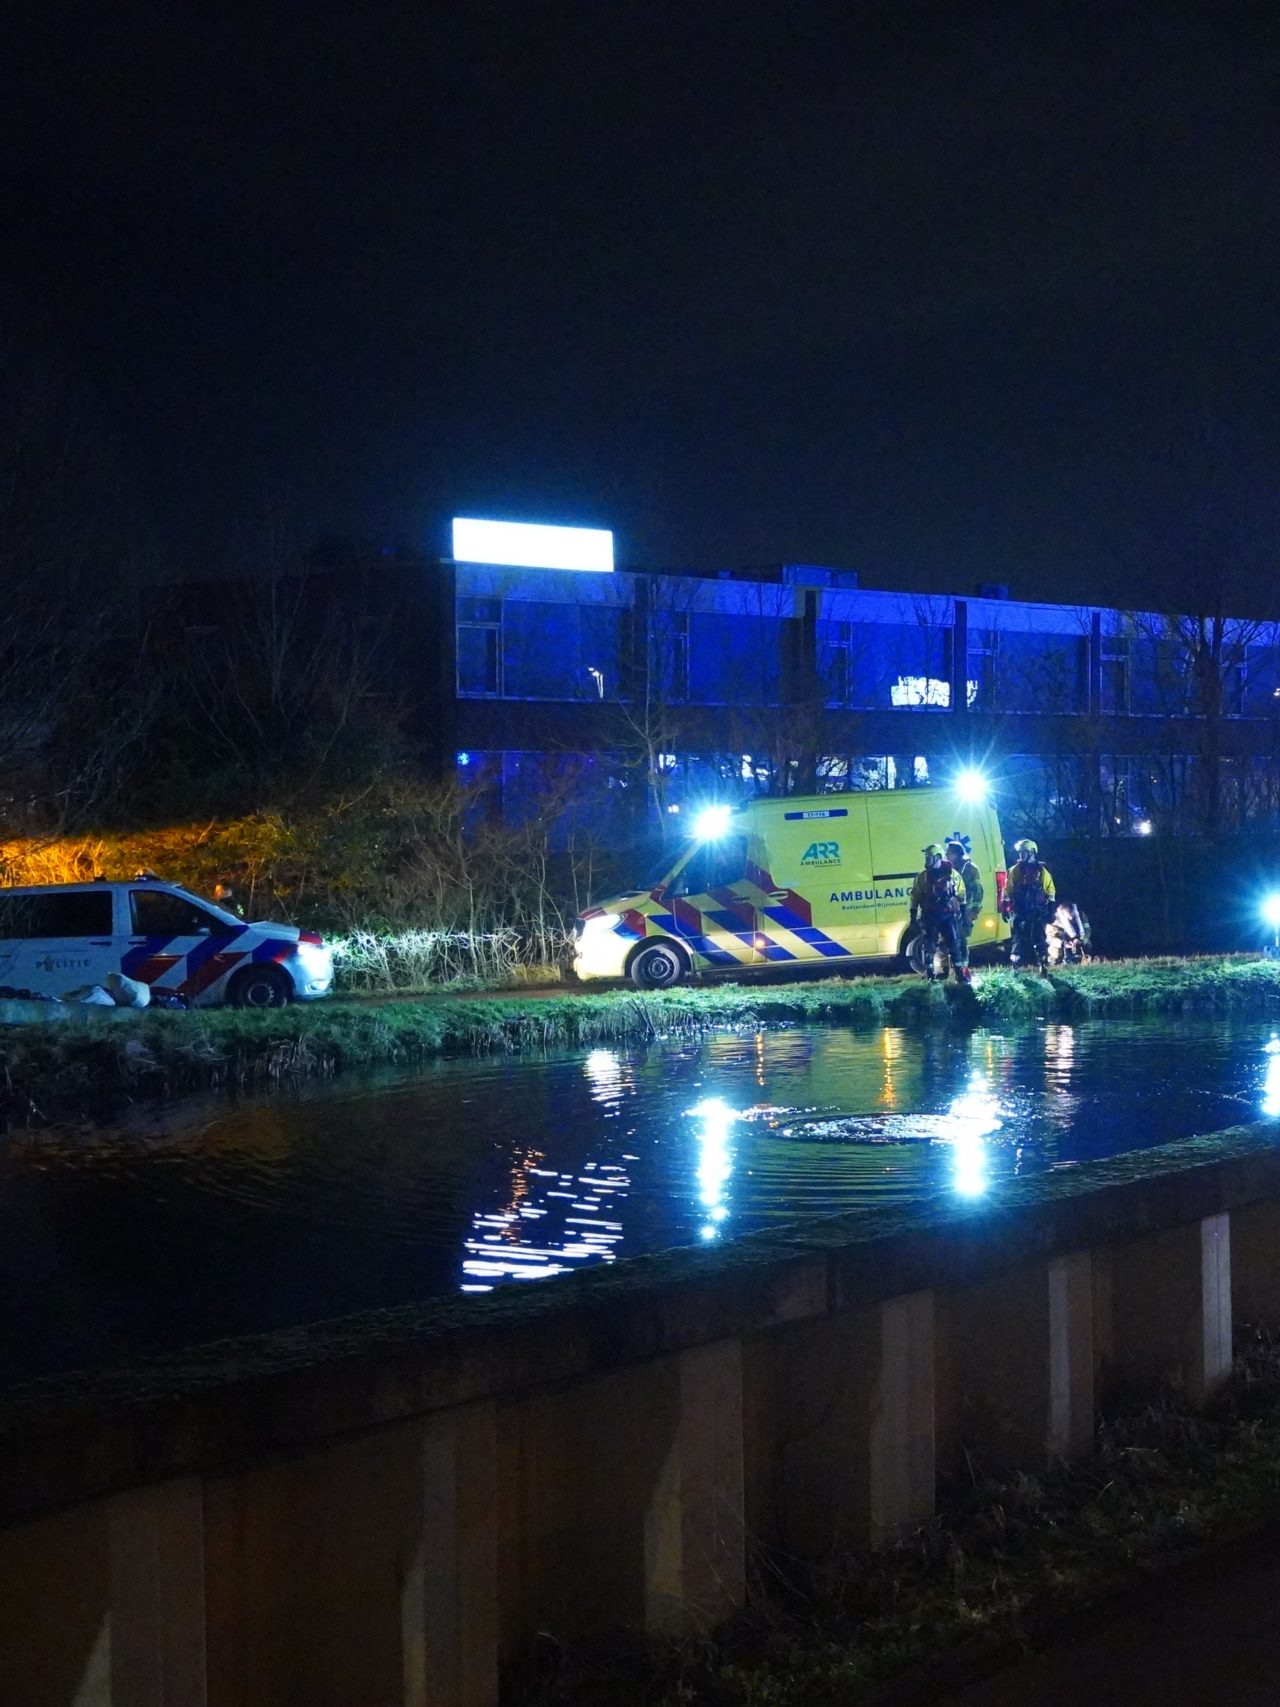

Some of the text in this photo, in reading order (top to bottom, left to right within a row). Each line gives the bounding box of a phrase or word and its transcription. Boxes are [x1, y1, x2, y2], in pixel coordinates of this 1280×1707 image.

[802, 841, 840, 860] ARR
[800, 859, 841, 867] AMBULANCE
[830, 887, 914, 903] AMBULANC
